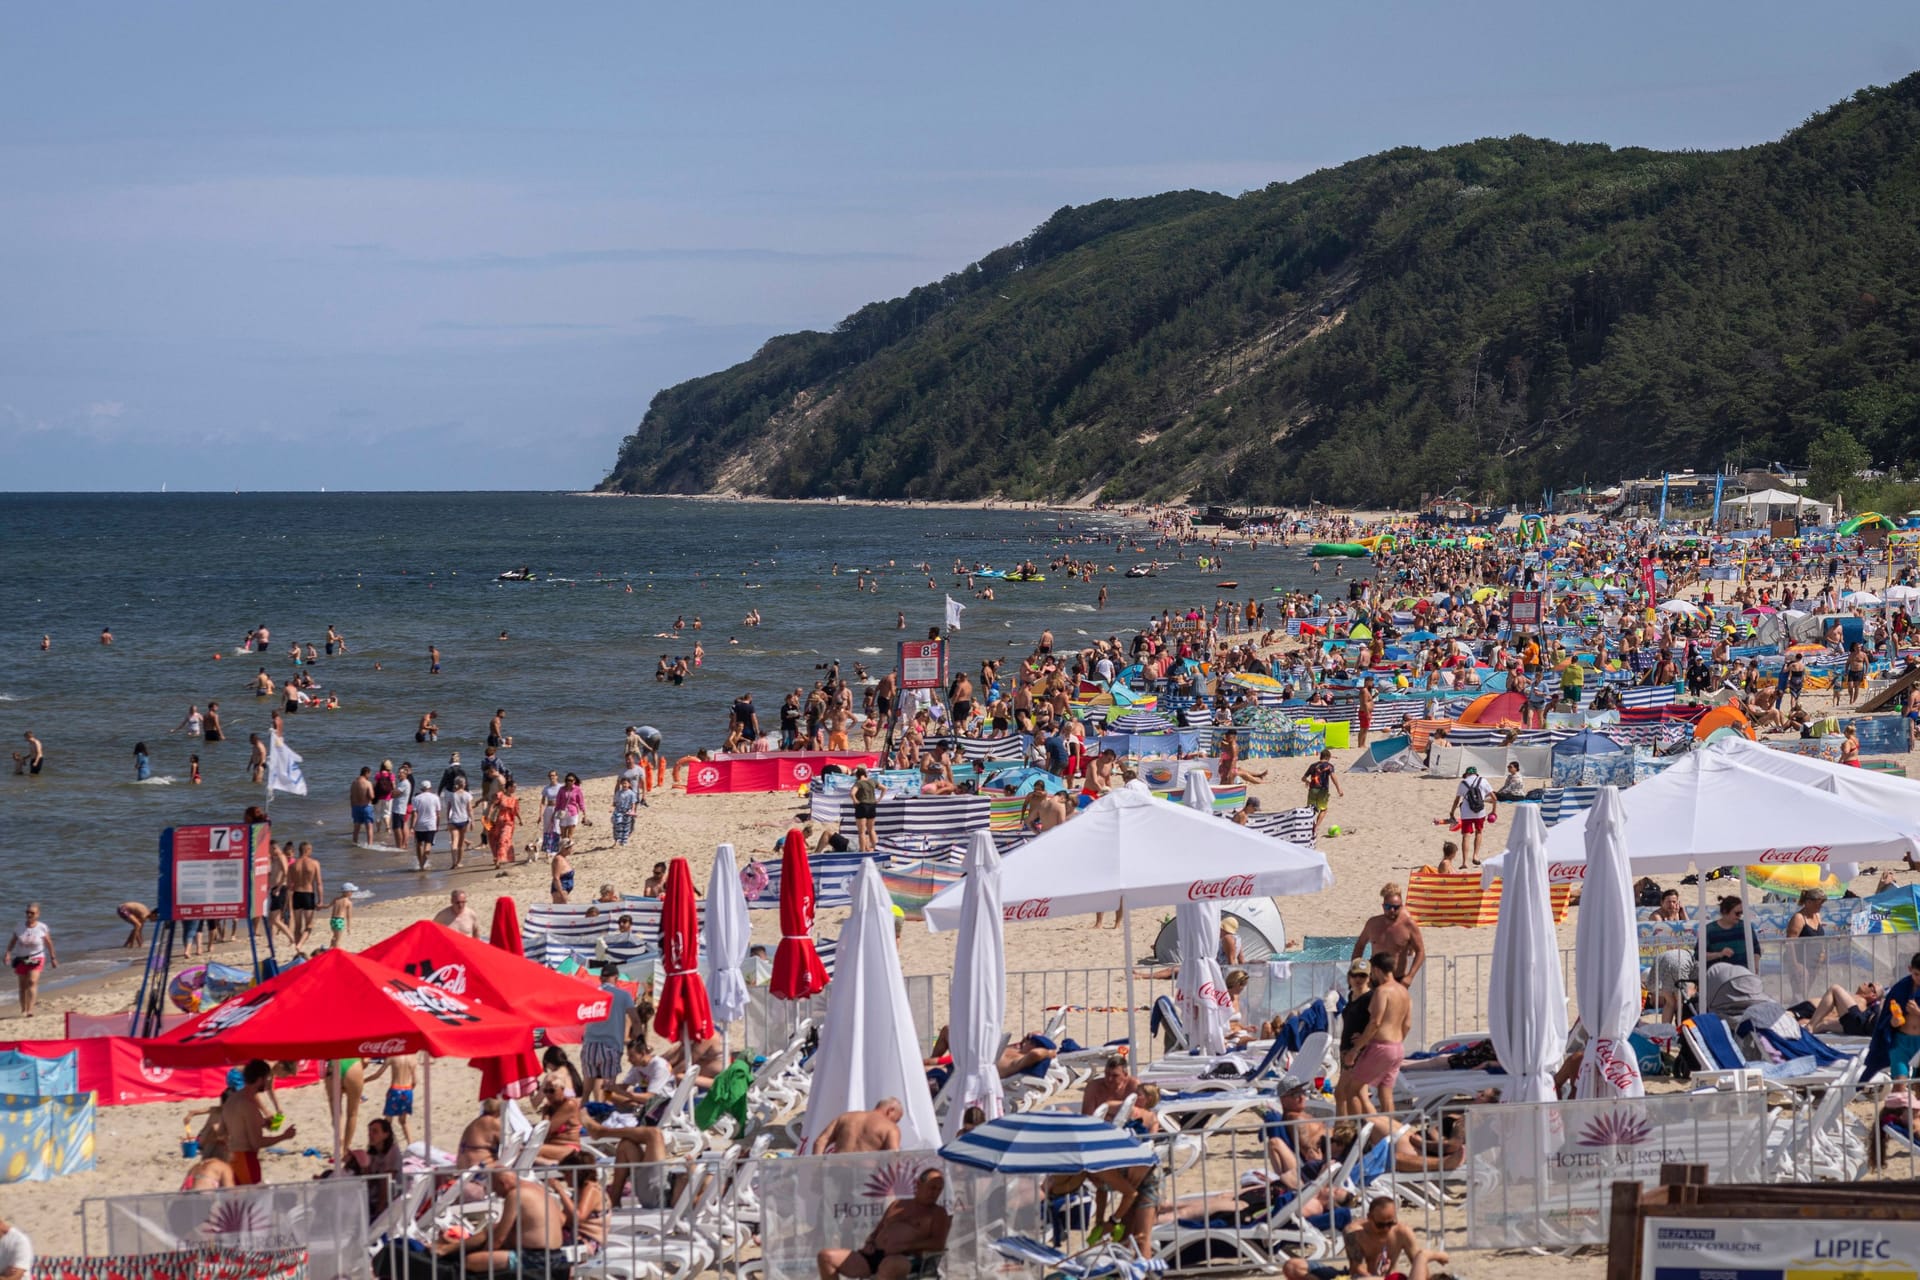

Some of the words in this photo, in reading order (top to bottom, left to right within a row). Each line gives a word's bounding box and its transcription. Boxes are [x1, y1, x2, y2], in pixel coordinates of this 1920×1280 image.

[922, 646, 930, 656] 8
[213, 830, 227, 849] 7
[1759, 846, 1833, 863] Coca-Cola
[1188, 874, 1257, 901] Coca-Cola
[577, 1001, 607, 1020] Coca-Cola
[358, 1038, 407, 1054] Coca-Cola
[1814, 1239, 1892, 1259] LIPIEC
